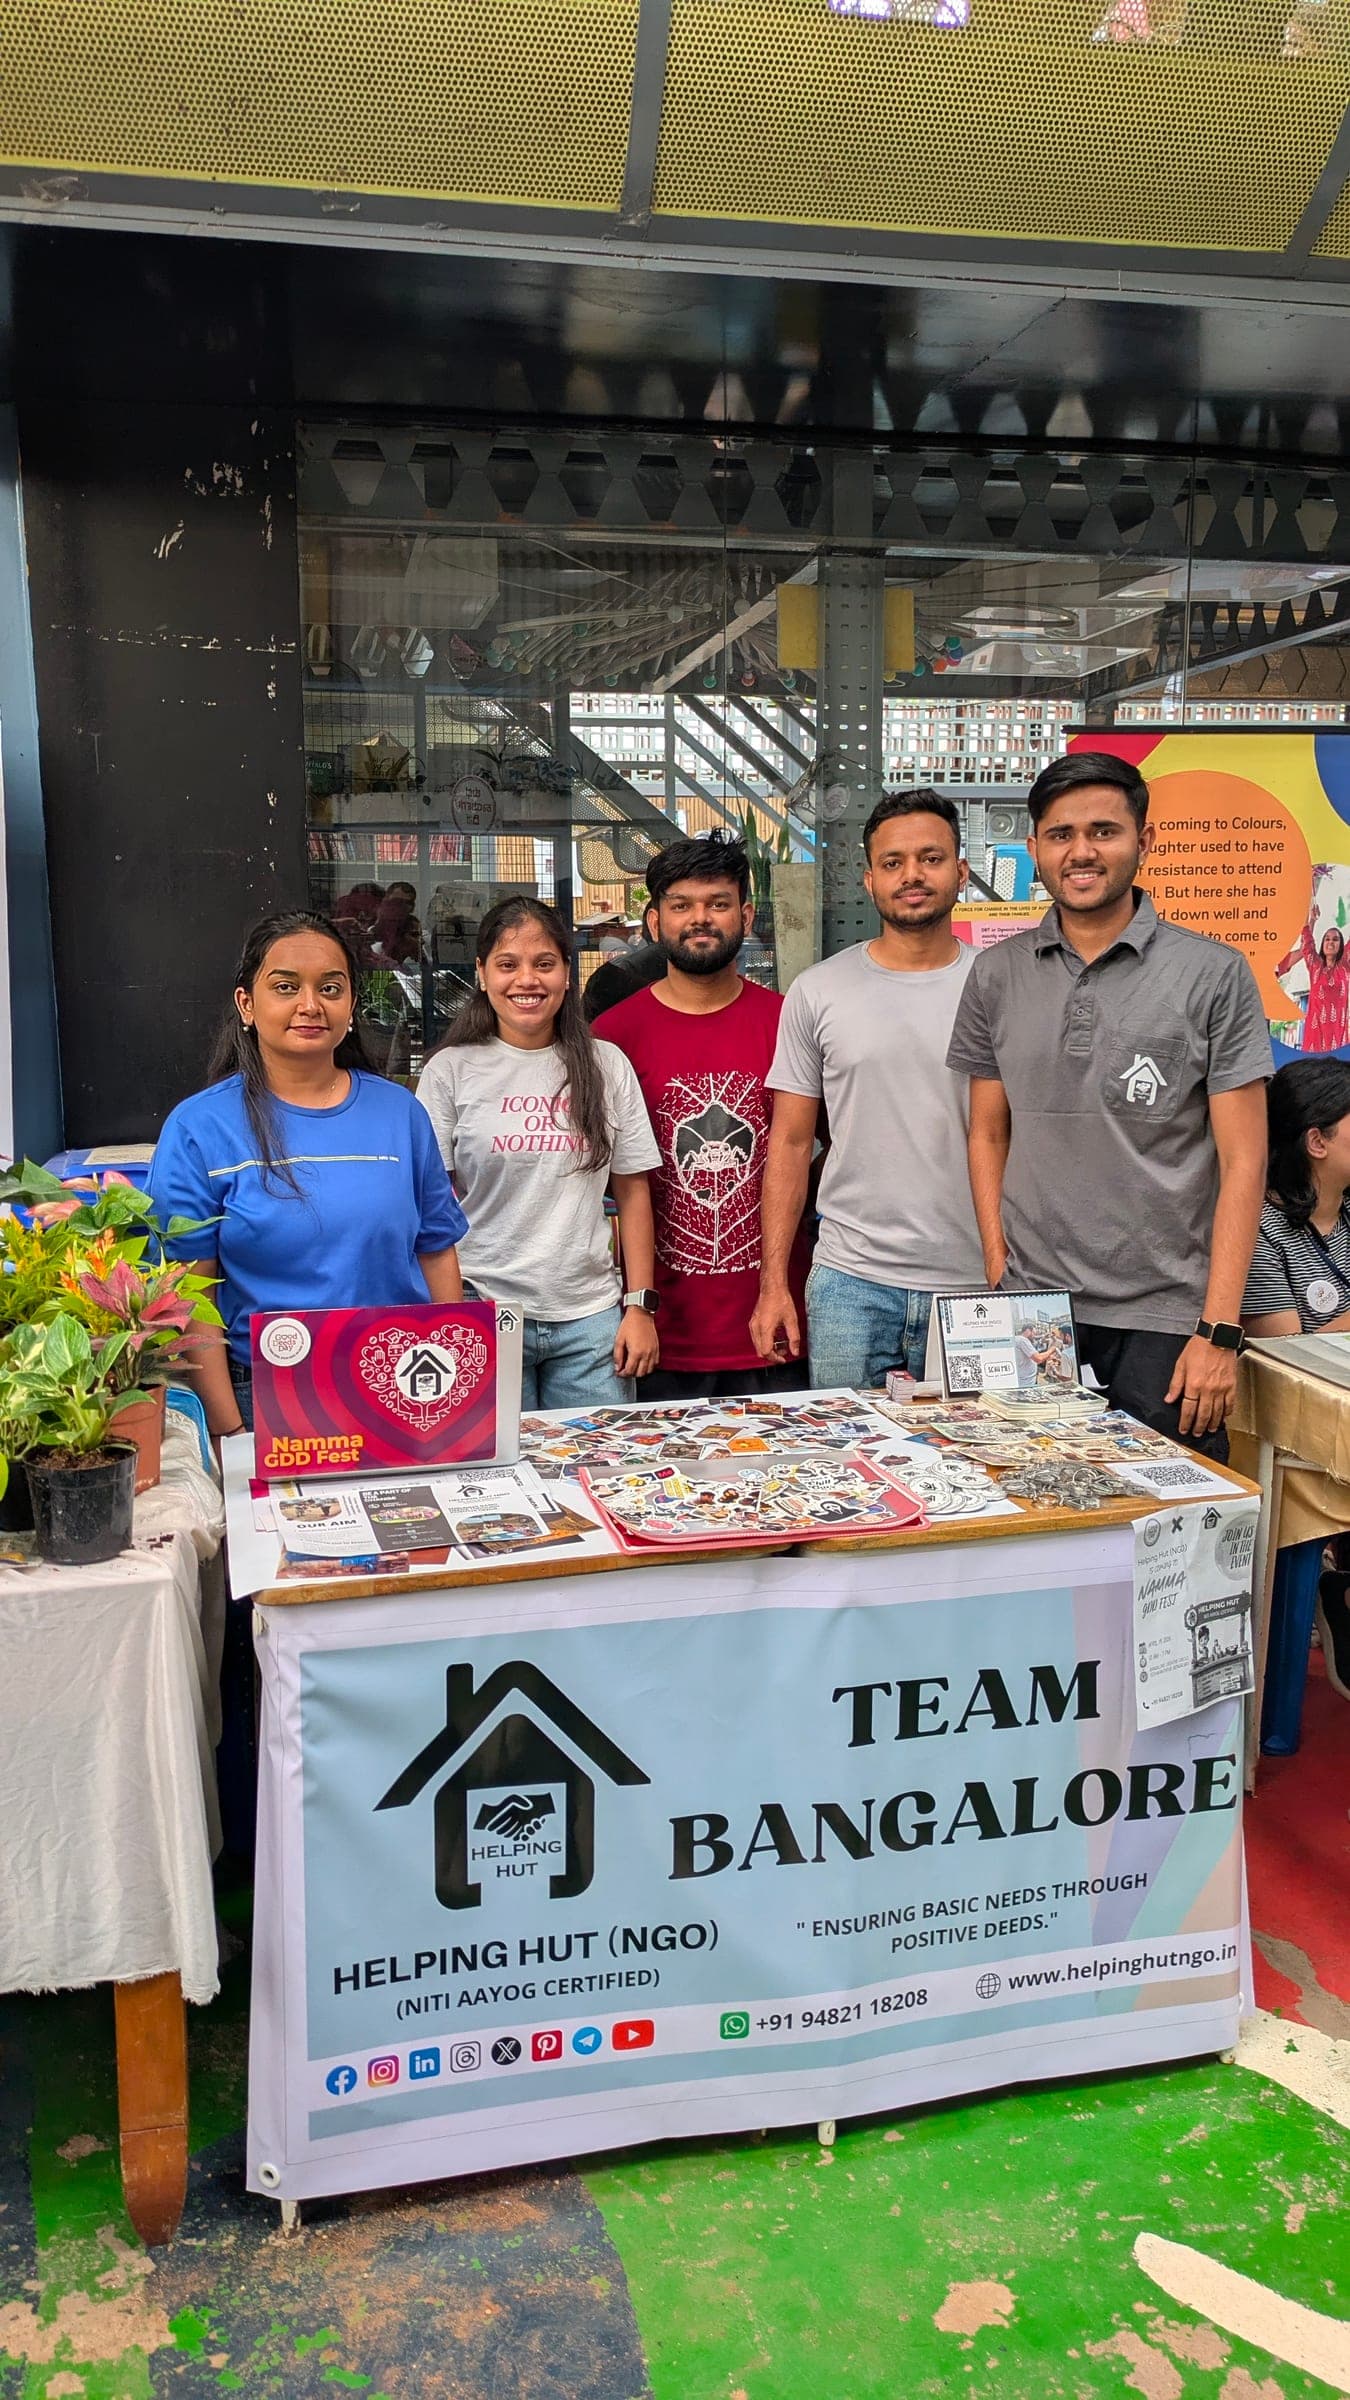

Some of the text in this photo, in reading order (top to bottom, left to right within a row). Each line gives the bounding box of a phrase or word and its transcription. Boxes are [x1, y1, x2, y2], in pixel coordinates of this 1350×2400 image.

[1159, 817, 1211, 832] coming
[1215, 818, 1228, 830] to
[1232, 816, 1287, 831] Colours,
[1149, 839, 1285, 856] ughter used to have
[1148, 863, 1218, 876] resistance
[1221, 863, 1235, 875] to
[1238, 861, 1282, 874] attend
[1165, 886, 1190, 899] But
[1194, 885, 1223, 898] here
[1226, 885, 1249, 897] she
[1253, 884, 1277, 897] has
[1170, 908, 1209, 921] down
[1213, 907, 1239, 920] well
[1243, 906, 1268, 919] and
[1225, 931, 1259, 942] come
[1263, 929, 1278, 941] to
[524, 1115, 556, 1131] OR
[272, 1434, 364, 1453] Namma
[264, 1448, 360, 1468] GDD Fest
[330, 1519, 357, 1527] AIM
[1222, 1525, 1255, 1543] JOIN US
[1230, 1540, 1252, 1555] IN THE
[1230, 1552, 1252, 1569] EVENT
[1138, 1570, 1187, 1602] NAMMA
[1159, 1592, 1179, 1610] FEST
[1226, 1597, 1240, 1607] HUT
[832, 1660, 1102, 1748] TEAM
[668, 1754, 1238, 1881] BANGALORE
[471, 1839, 563, 1861] HELPING
[496, 1862, 538, 1878] HUT
[812, 1908, 916, 1939] ENSURING
[922, 1897, 980, 1921] BASIC
[984, 1886, 1048, 1913] NEEDS
[1051, 1871, 1149, 1901] THROUGH
[891, 1911, 1059, 1954] POSITIVE DEEDS."
[333, 1919, 719, 1995] HELPING HUT (NGO)
[1008, 1943, 1237, 1992] www.helpinghutngo.in
[396, 1968, 660, 2020] (NITI AAYOG CERTIFIED)
[756, 1988, 928, 2033] +91 94821 18208
